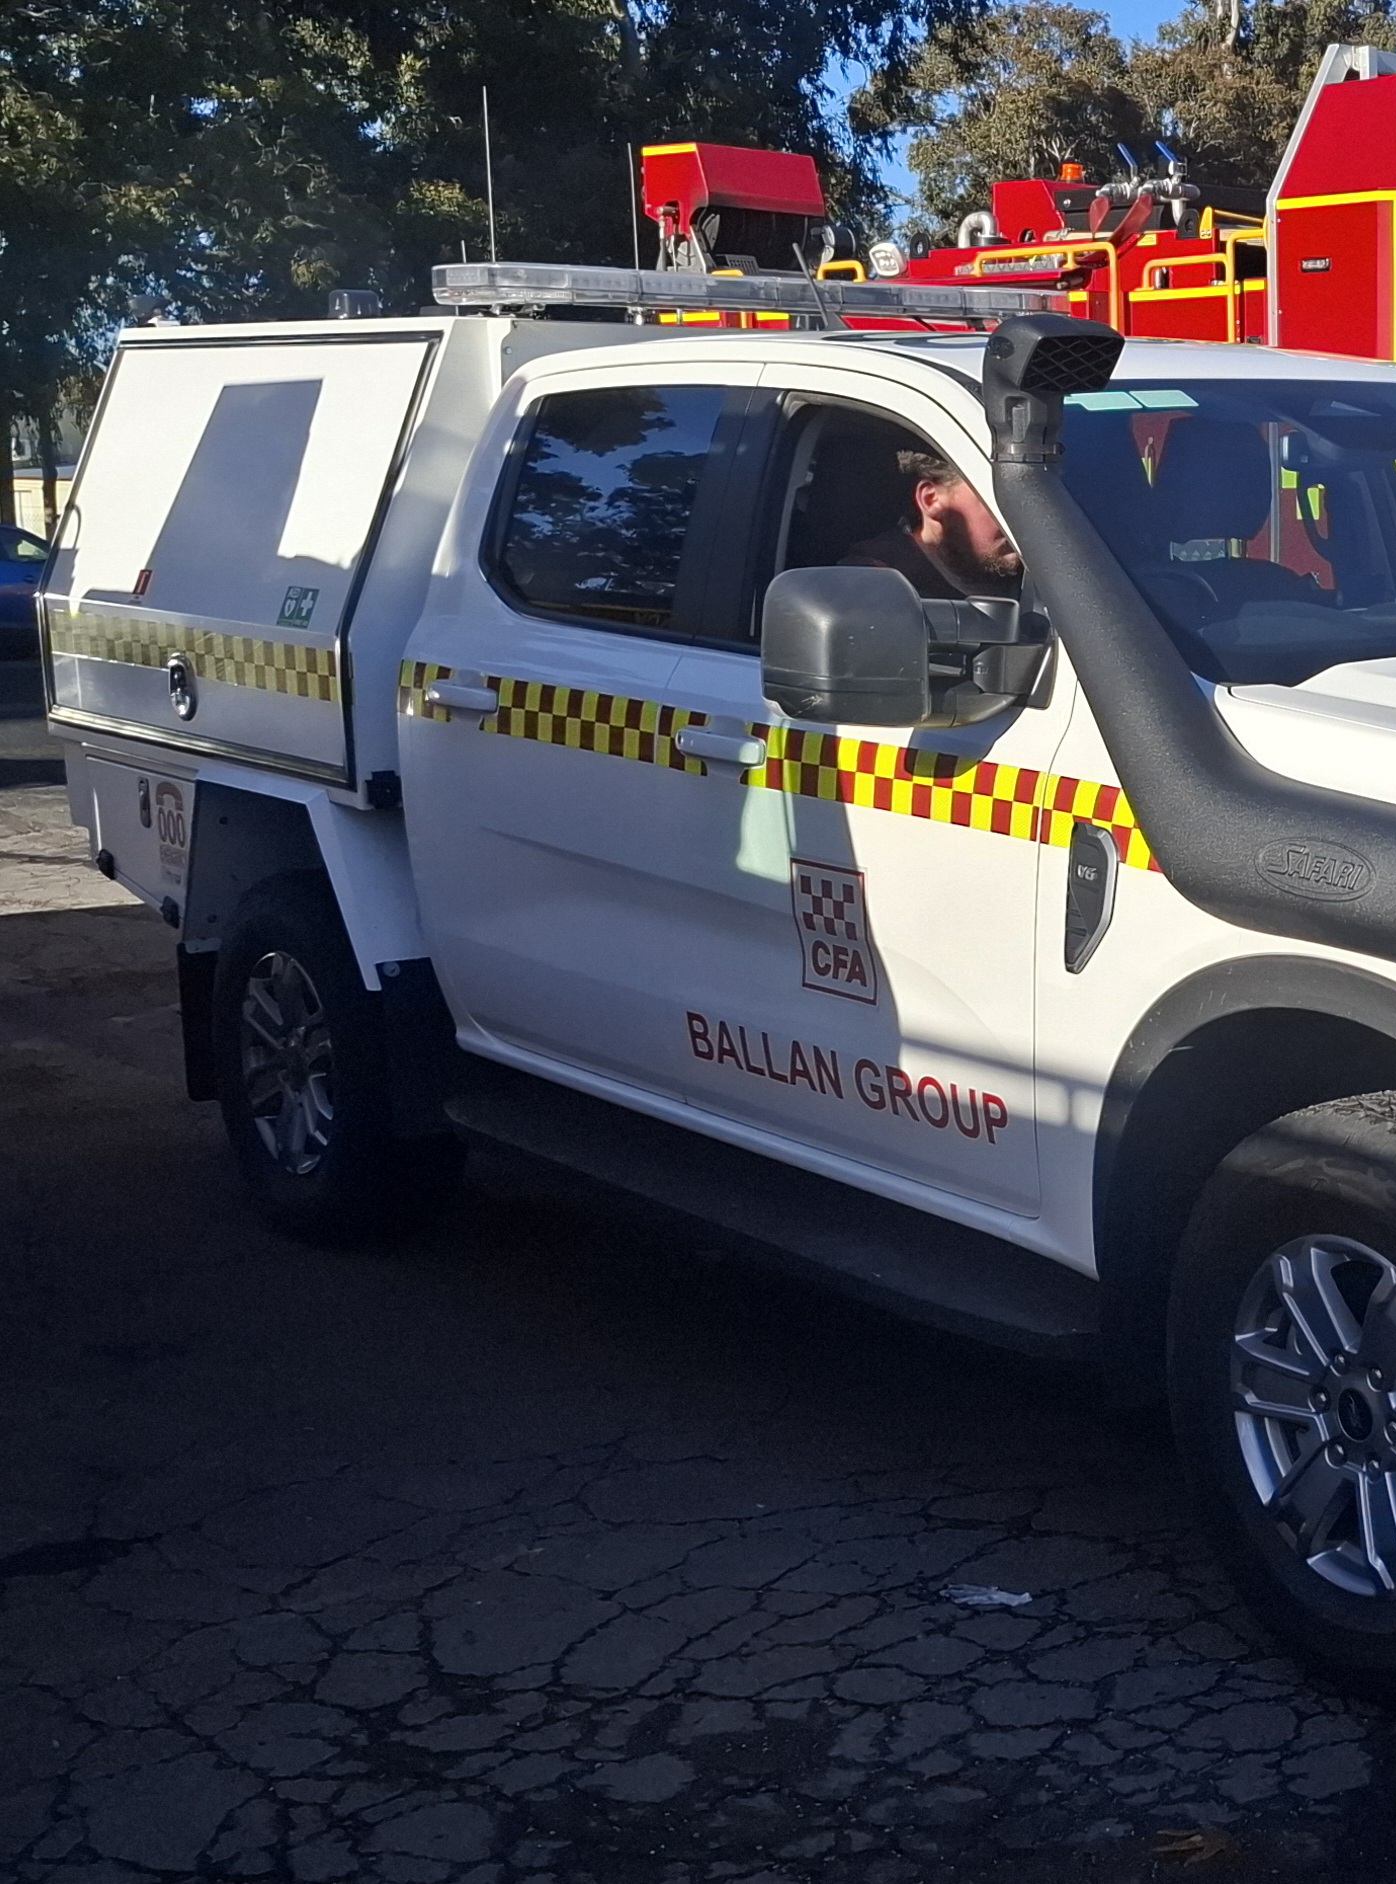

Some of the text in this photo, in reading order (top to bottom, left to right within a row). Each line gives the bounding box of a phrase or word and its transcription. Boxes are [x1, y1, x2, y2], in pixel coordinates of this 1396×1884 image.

[158, 807, 186, 849] 000
[1077, 864, 1097, 880] V6
[1266, 842, 1364, 890] SAFARI
[811, 939, 868, 988] CFA
[686, 1010, 1009, 1145] BALLAN GROUP
